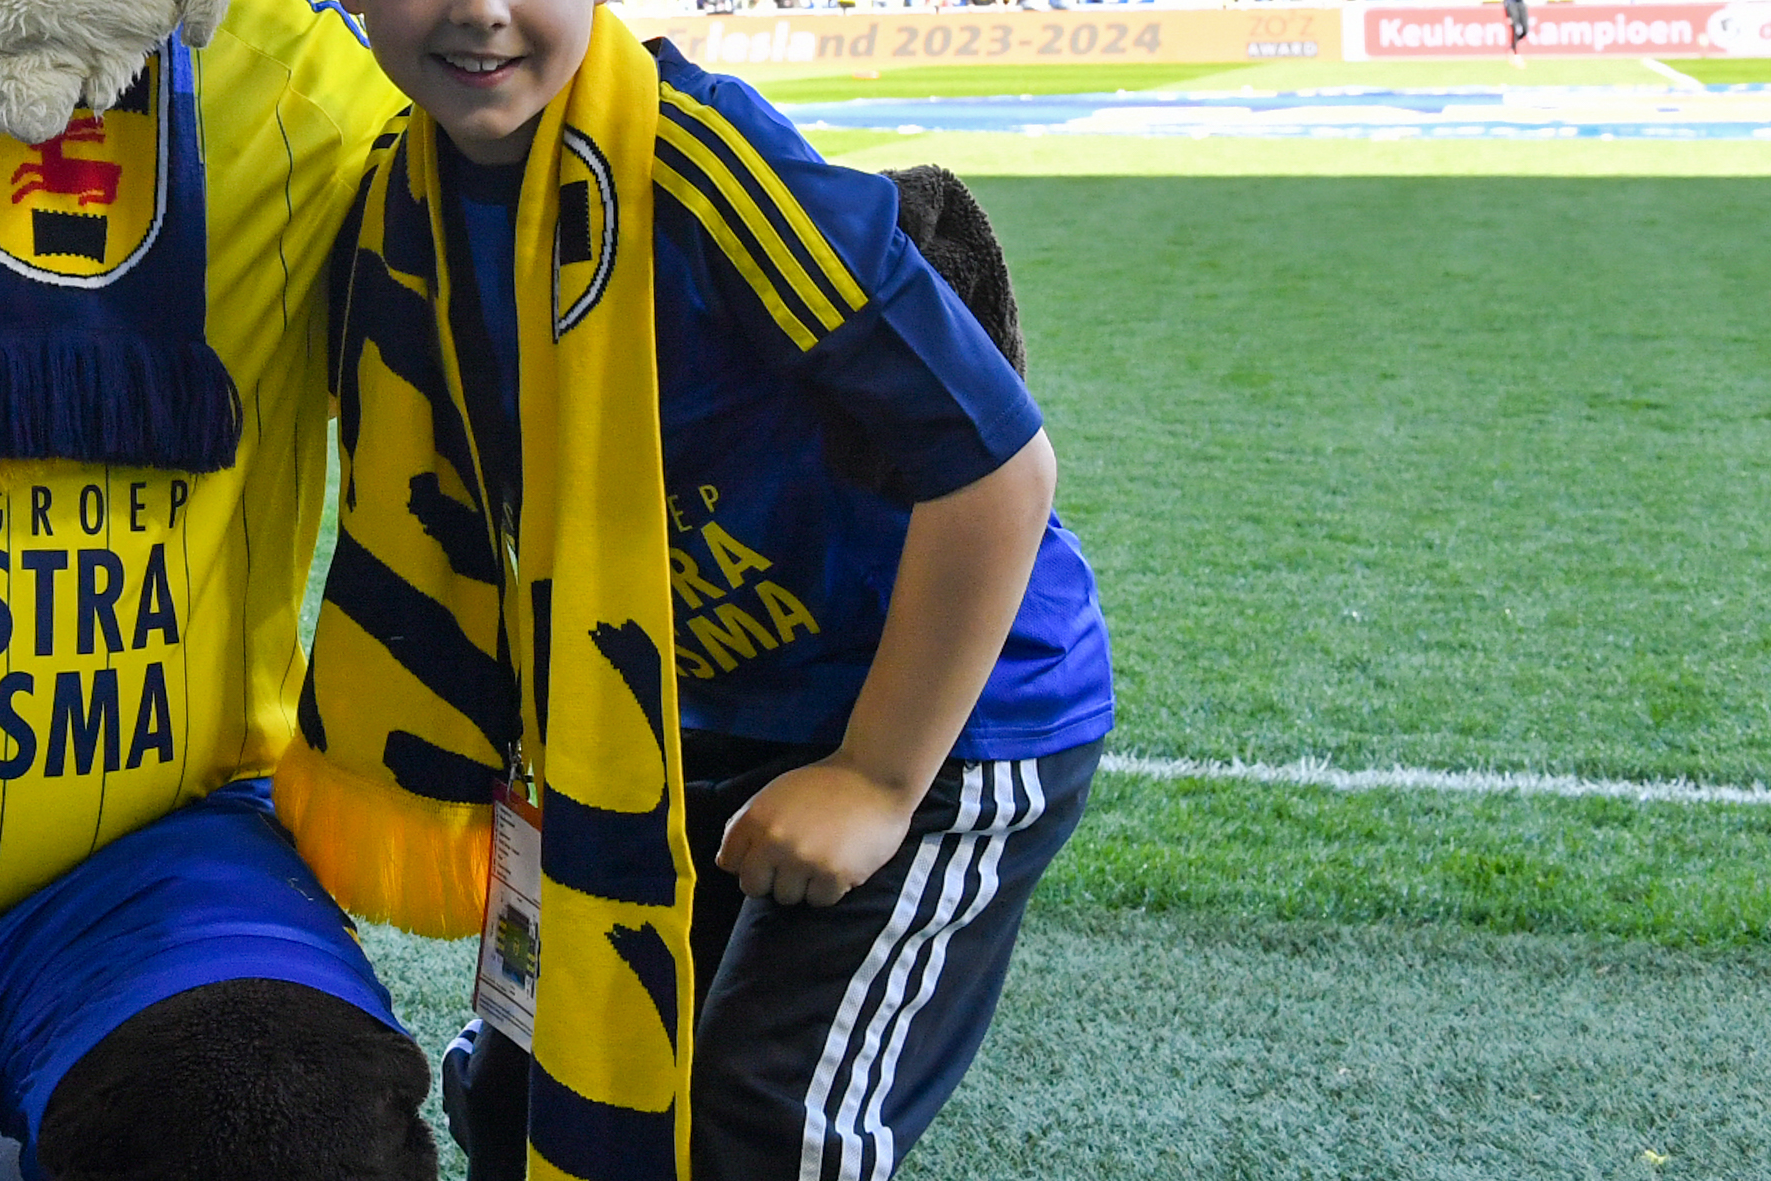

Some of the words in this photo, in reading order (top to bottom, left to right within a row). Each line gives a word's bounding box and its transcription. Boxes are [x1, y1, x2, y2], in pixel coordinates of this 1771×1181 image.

[890, 21, 1163, 59] 2023-2024
[1378, 15, 1506, 47] Keuken
[1247, 40, 1319, 57] AWARD
